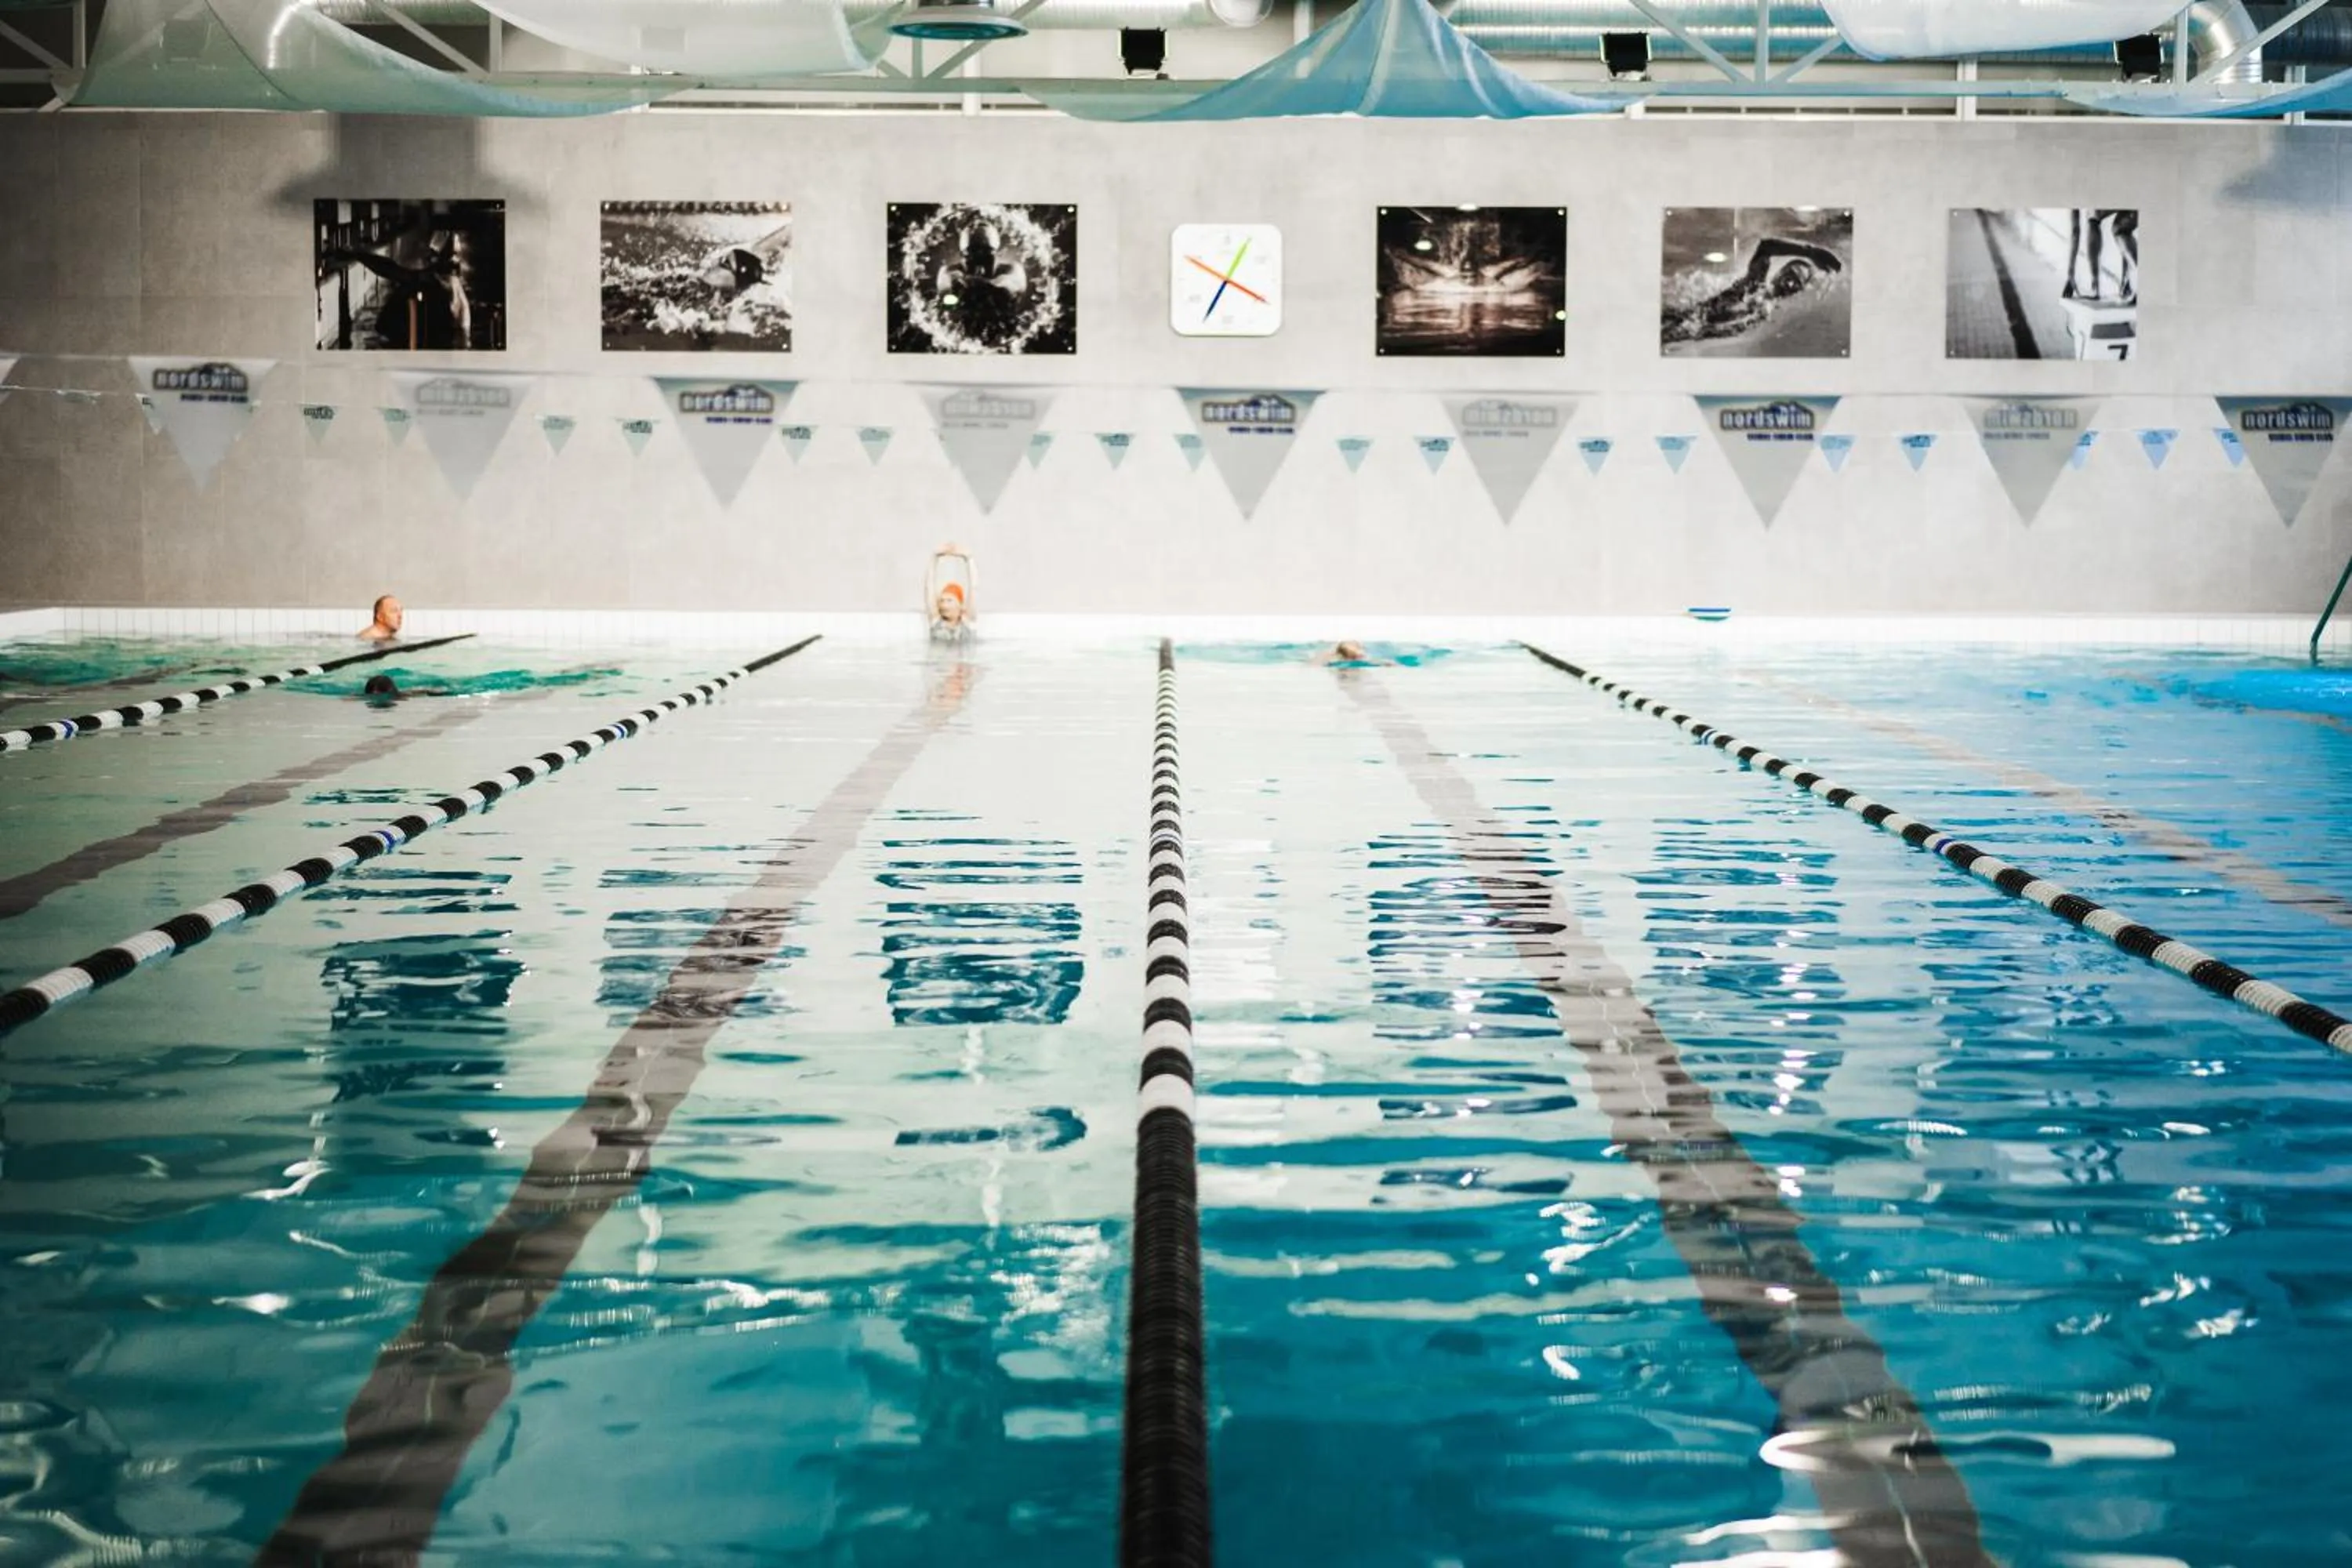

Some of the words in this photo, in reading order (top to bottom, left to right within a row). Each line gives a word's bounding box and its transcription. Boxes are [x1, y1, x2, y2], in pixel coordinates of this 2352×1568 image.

[2107, 344, 2129, 361] 7
[1722, 404, 1812, 427] nordswim
[2245, 405, 2332, 428] nordswim
